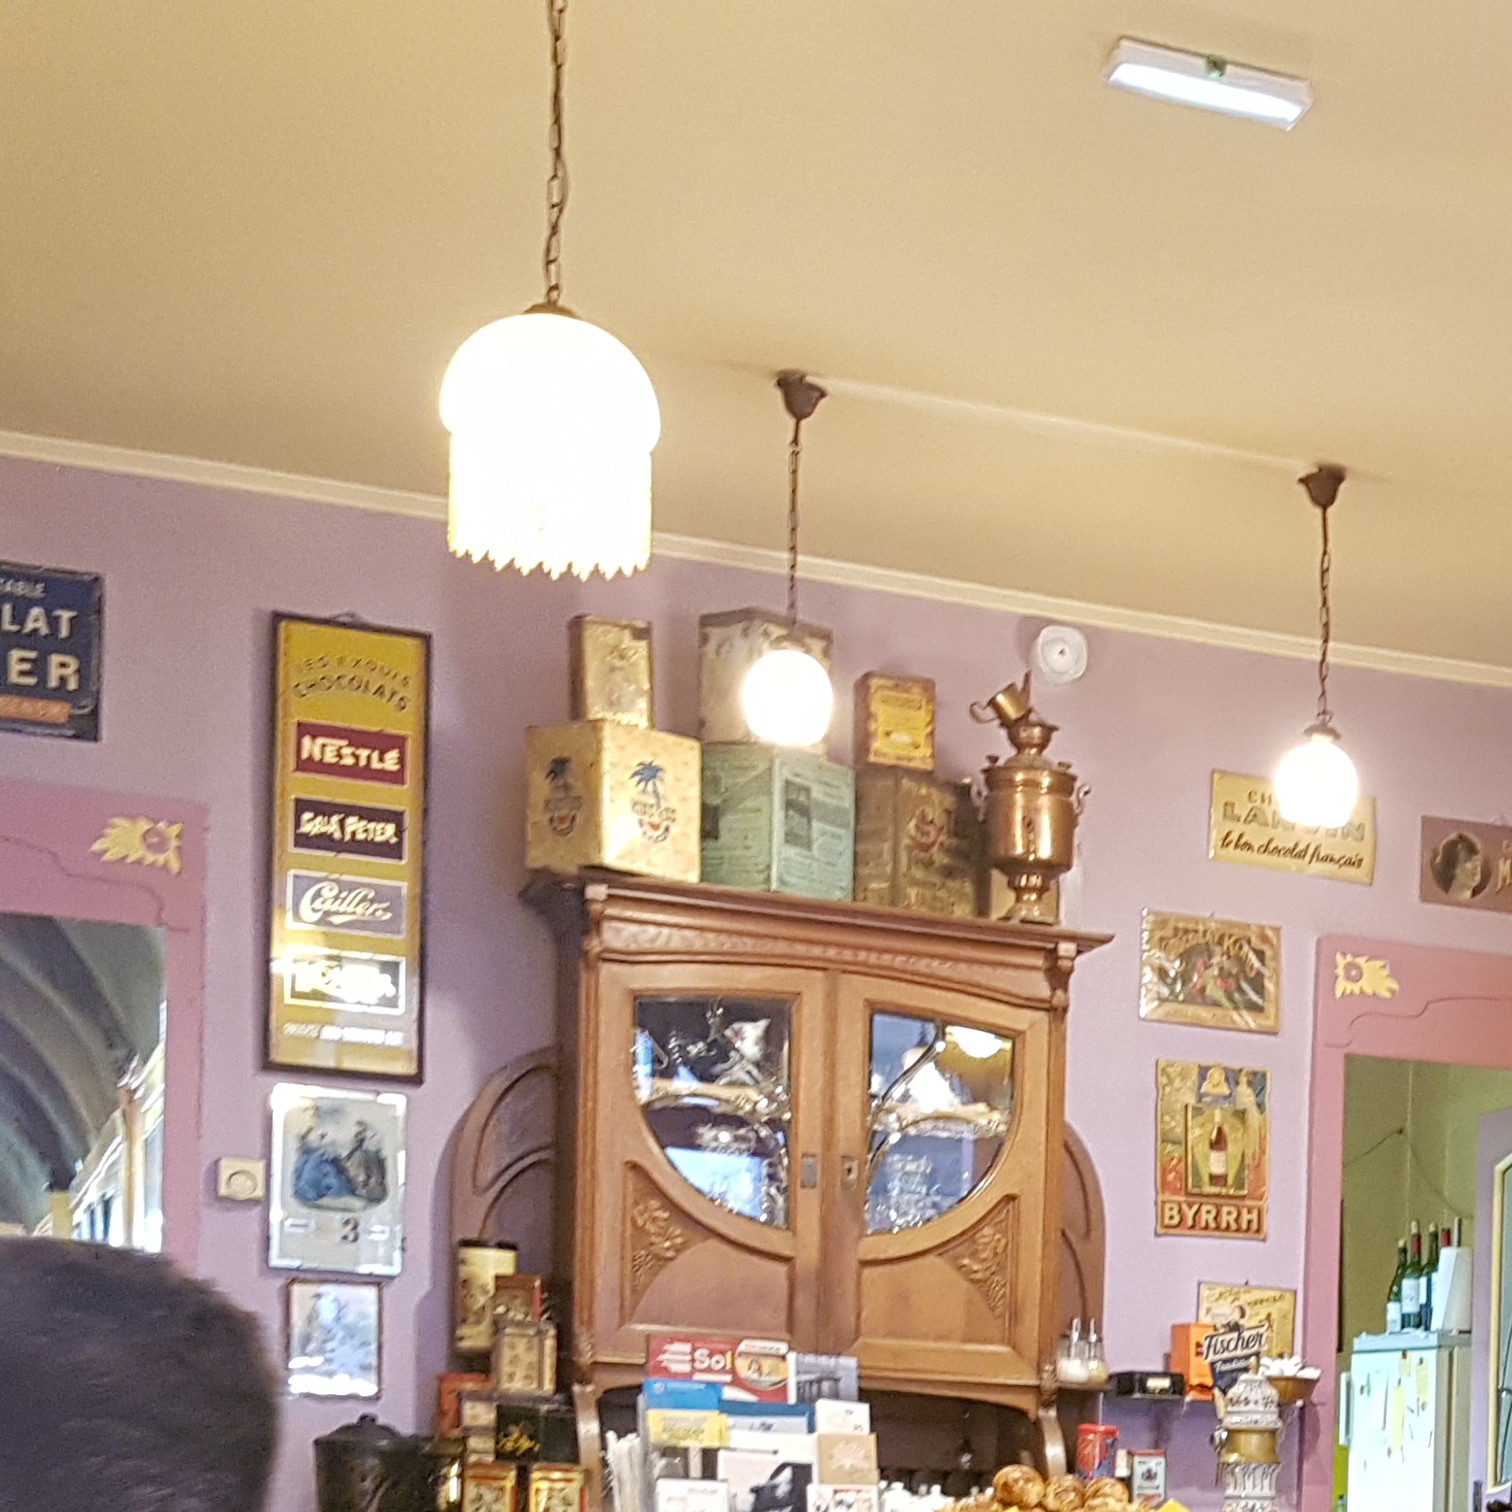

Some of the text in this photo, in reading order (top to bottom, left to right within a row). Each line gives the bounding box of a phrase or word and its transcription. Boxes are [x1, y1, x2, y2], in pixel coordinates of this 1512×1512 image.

[292, 674, 409, 713] CHOCOLATS
[1222, 801, 1366, 842] LANIN
[1234, 832, 1256, 853] bon
[1257, 838, 1311, 860] chocolat
[1306, 844, 1364, 869] français
[1163, 1203, 1261, 1232] BYRRH
[1203, 1330, 1265, 1361] Fischer
